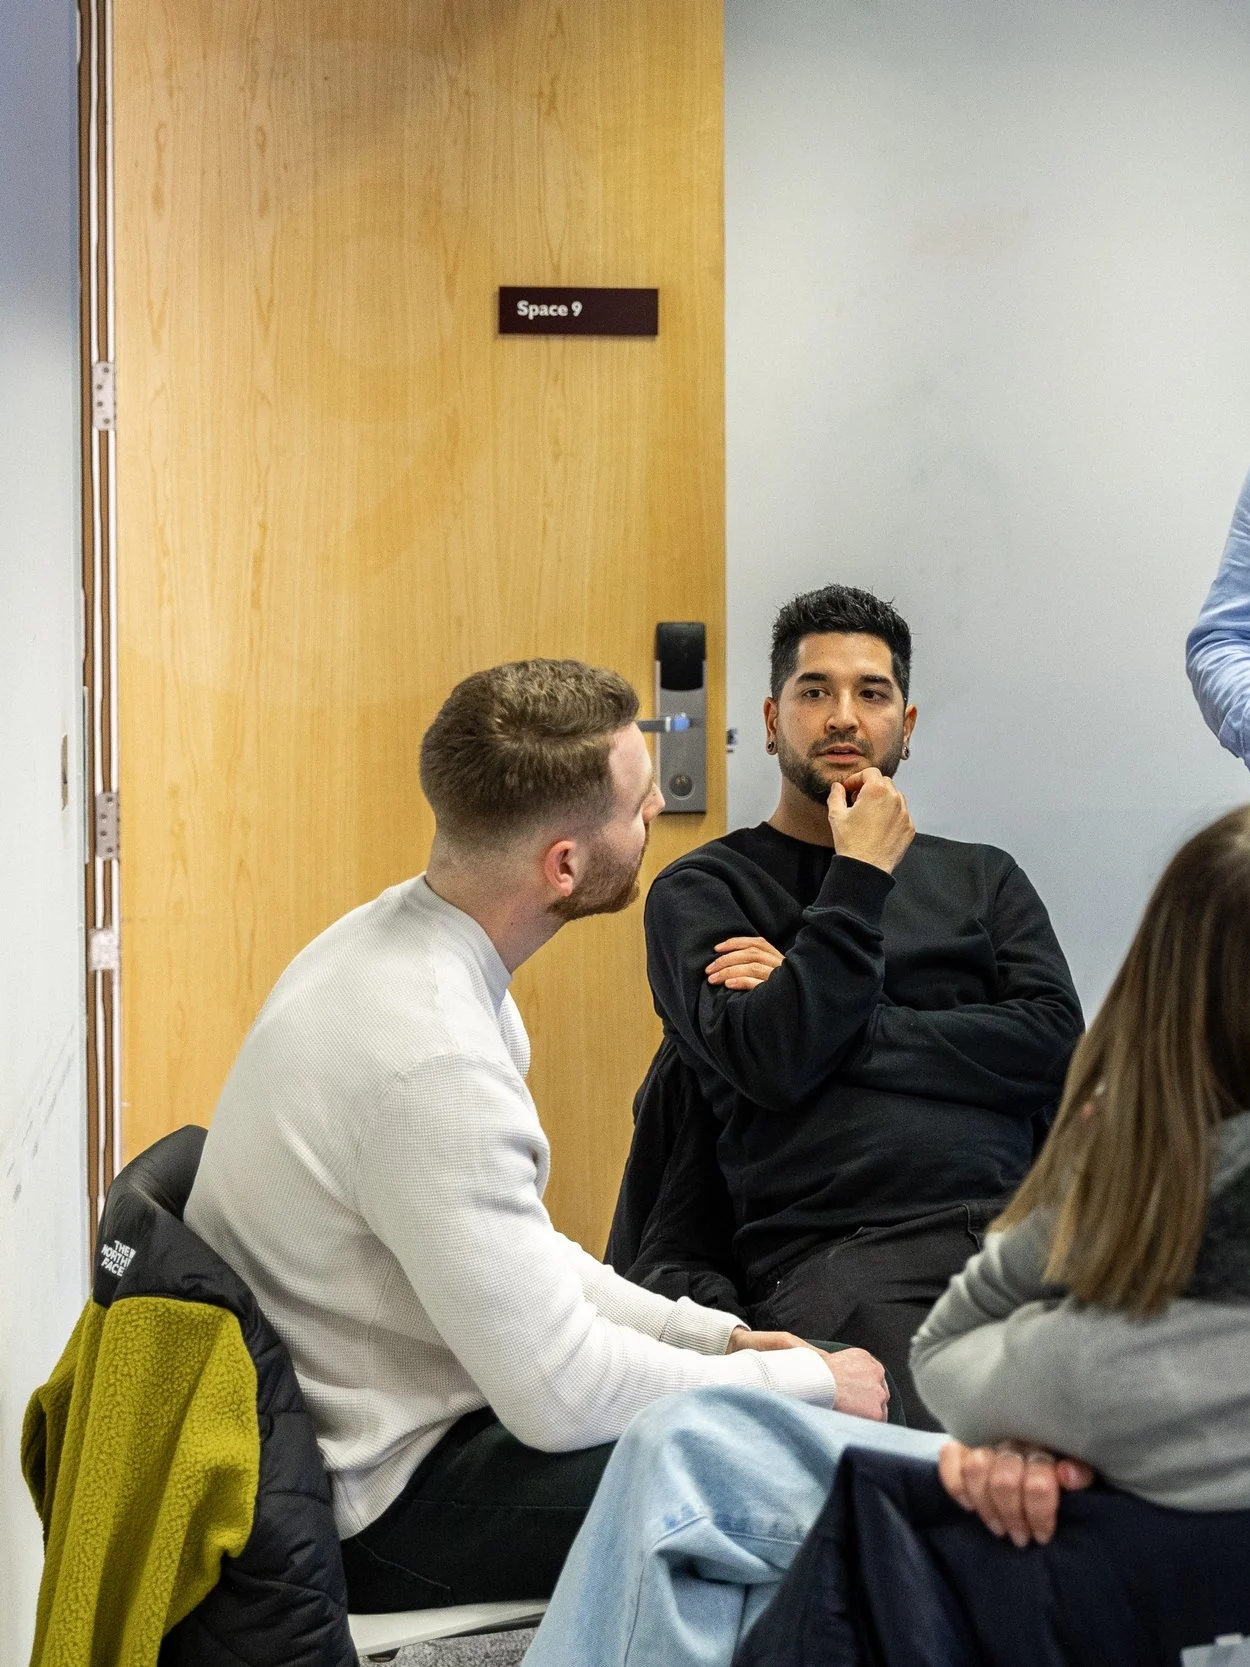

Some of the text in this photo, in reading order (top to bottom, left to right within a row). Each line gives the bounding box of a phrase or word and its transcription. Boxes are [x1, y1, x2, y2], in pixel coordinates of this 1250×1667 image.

[516, 300, 583, 320] Space 9
[101, 1244, 127, 1268] NORTH
[114, 1240, 131, 1257] THE
[101, 1257, 126, 1277] FACE
